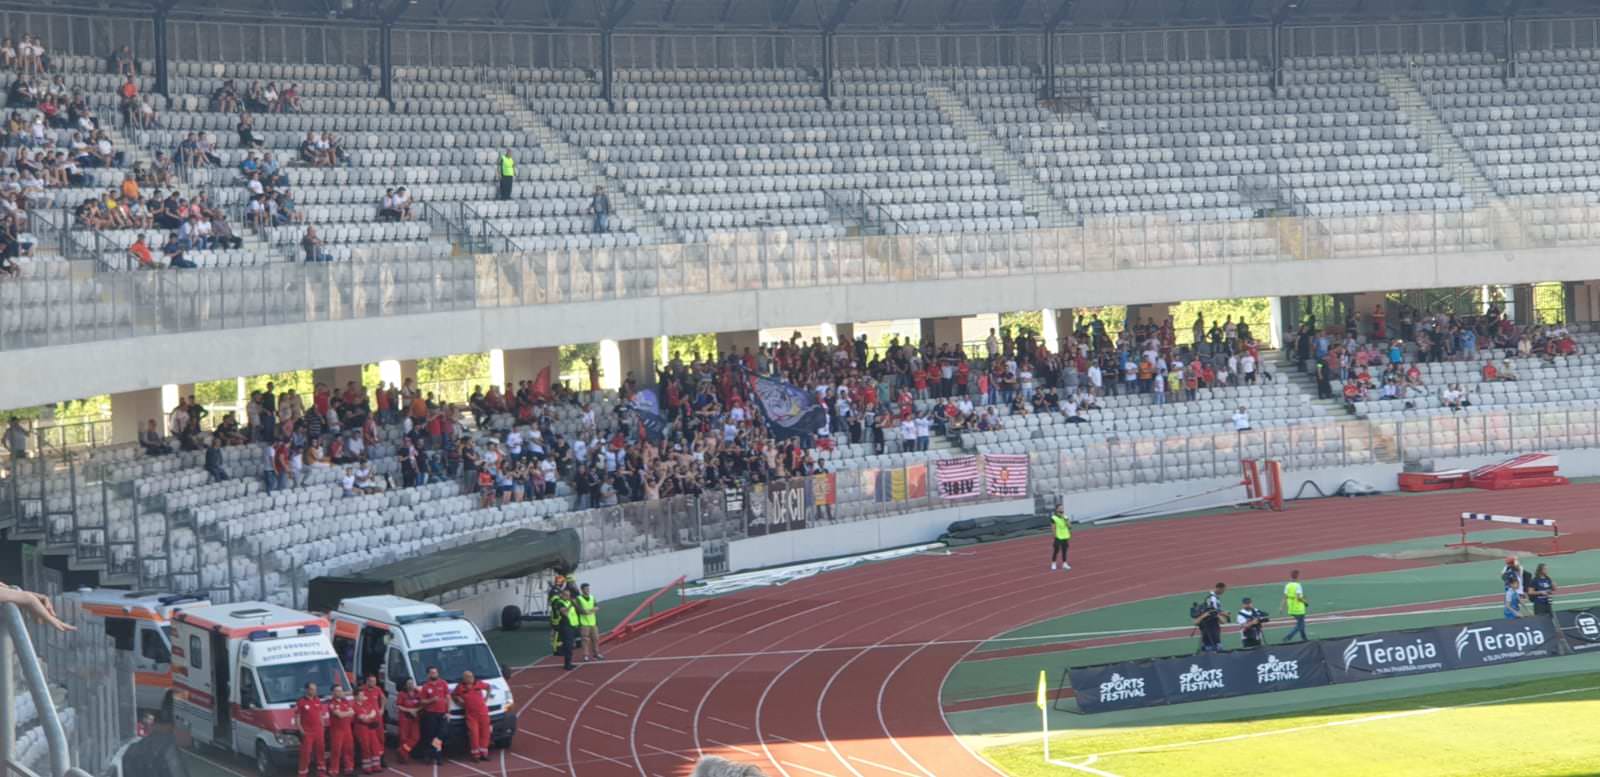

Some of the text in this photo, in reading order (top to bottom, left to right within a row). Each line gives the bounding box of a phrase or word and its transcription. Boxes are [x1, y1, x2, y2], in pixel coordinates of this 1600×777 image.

[1466, 626, 1545, 652] Terapia
[1356, 638, 1437, 665] Terapia
[1256, 660, 1299, 675] SPORTS
[1179, 668, 1224, 684] SPORTS
[1257, 669, 1300, 684] FESTIVAL
[1099, 678, 1145, 693] SPORTS
[1180, 679, 1225, 693] FESTIVAL
[1100, 687, 1146, 703] FESTIVAL
